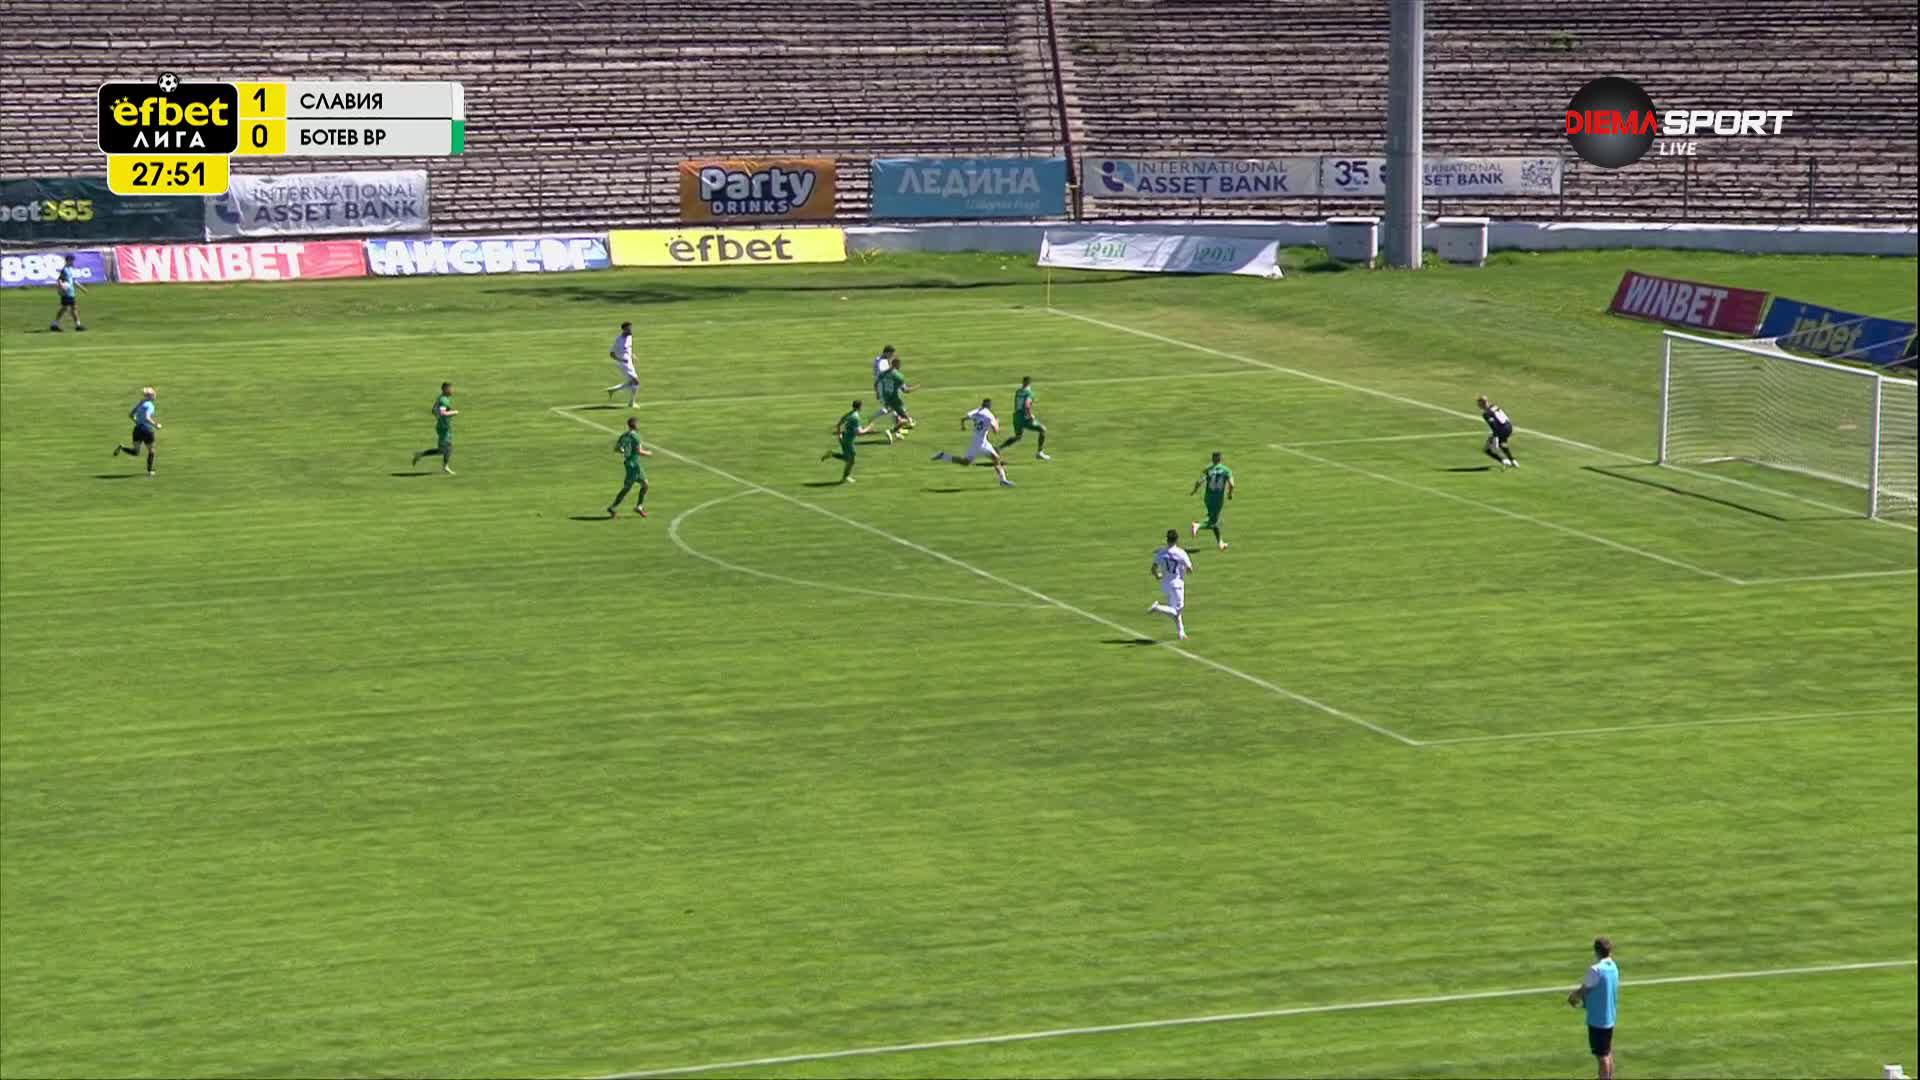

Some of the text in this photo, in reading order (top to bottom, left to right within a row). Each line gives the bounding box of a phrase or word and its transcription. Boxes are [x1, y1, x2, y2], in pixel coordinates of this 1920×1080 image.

[1136, 160, 1288, 174] INTERNATIONAL
[1423, 162, 1504, 174] ERNATIONAL
[701, 166, 816, 206] Party
[898, 167, 1041, 198] ЛЕДИНА
[1136, 175, 1289, 194] ASSET BANK
[1457, 172, 1504, 186] BANK
[253, 183, 416, 201] INTERNATIONAL
[254, 200, 418, 223] ASSET BANK
[711, 200, 789, 215] DRINKS
[667, 233, 793, 262] efbet
[129, 244, 304, 282] WINBET
[1622, 275, 1729, 327] WINBET
